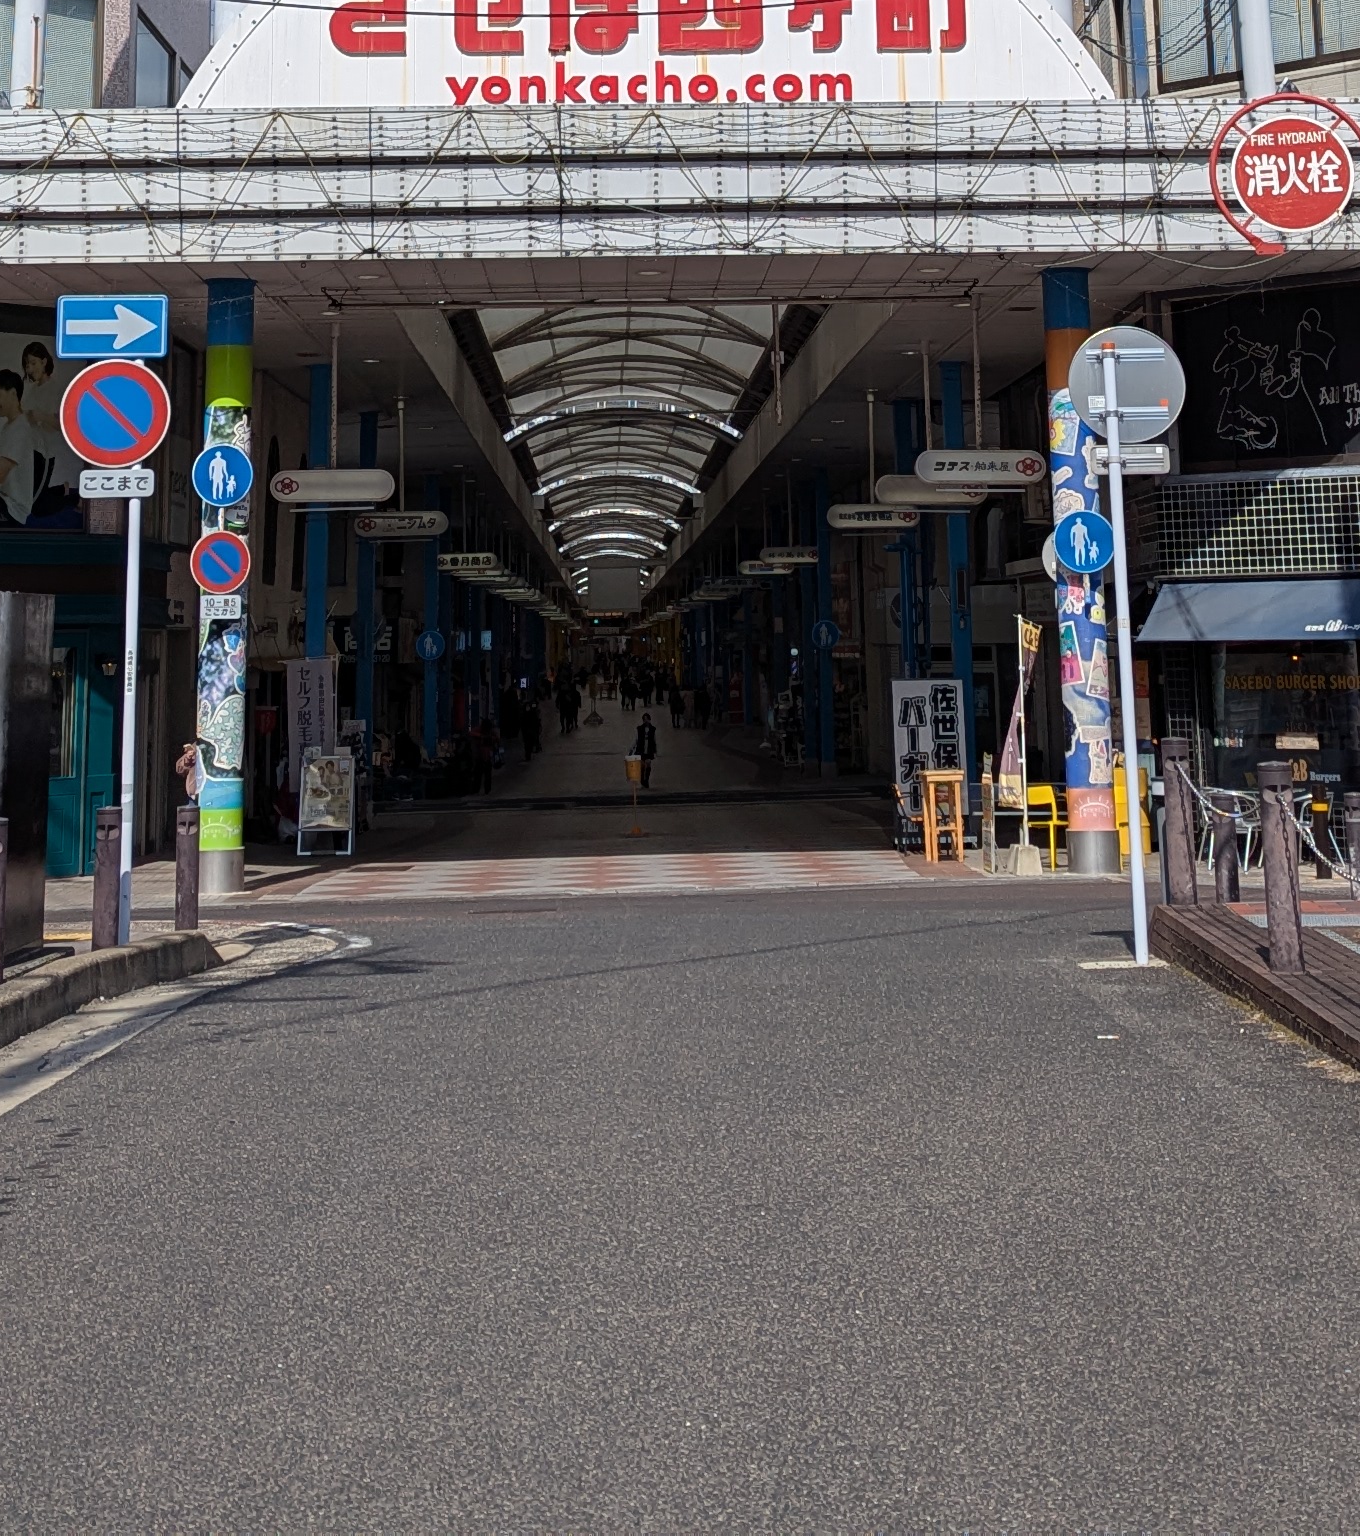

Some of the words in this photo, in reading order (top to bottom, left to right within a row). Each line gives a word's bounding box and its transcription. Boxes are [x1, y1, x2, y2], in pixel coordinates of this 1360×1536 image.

[445, 60, 853, 107] yonkacho.com
[1250, 134, 1275, 147] FIRE
[1277, 131, 1328, 145] HYDRANT
[1243, 151, 1344, 197] 消火栓
[1319, 387, 1340, 405] All
[84, 476, 149, 491] ここまで
[1225, 675, 1272, 690] SASEBO
[1276, 675, 1326, 690] BURGER
[930, 685, 960, 770] 佐世保
[899, 697, 928, 811] バーガー
[1310, 771, 1342, 783] Burgers
